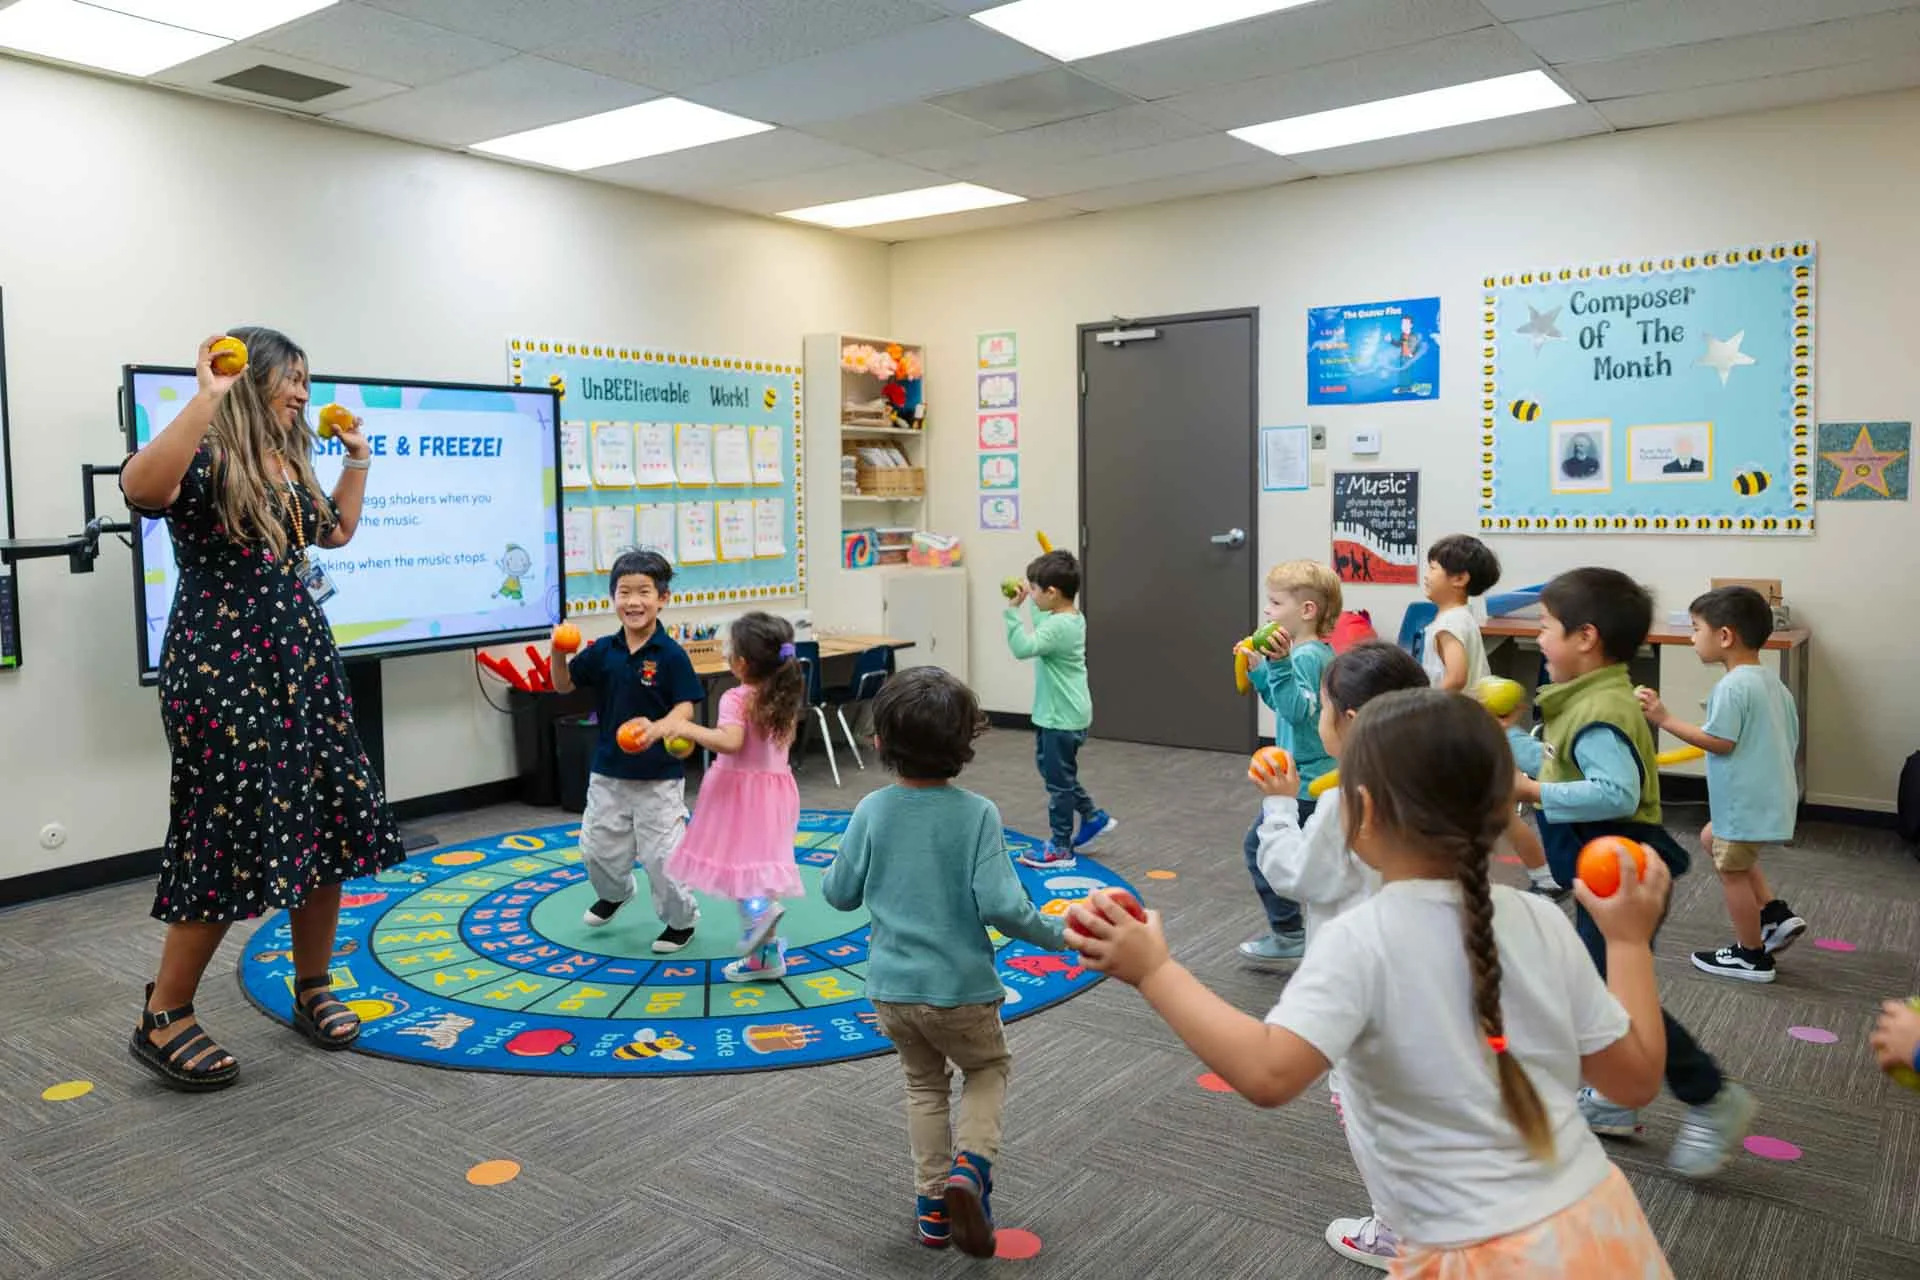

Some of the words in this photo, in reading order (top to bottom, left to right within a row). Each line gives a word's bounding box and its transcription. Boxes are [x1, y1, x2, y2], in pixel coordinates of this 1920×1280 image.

[1570, 286, 1696, 318] Composer
[1579, 320, 1611, 350] Of
[1636, 317, 1685, 345] The
[1593, 351, 1673, 381] Month
[582, 376, 690, 404] UnBEElievable
[710, 384, 750, 408] Work!
[396, 435, 411, 457] &
[419, 436, 503, 458] FREEZE!
[1346, 473, 1407, 496] Music
[389, 490, 437, 507] shakers
[439, 491, 469, 505] when
[471, 493, 492, 506] you
[359, 514, 381, 527] the
[357, 555, 392, 571] when
[394, 554, 414, 569] the
[416, 554, 452, 568] music
[378, 929, 452, 945] Ww
[826, 944, 860, 957] 5
[546, 954, 597, 974] 26
[663, 966, 698, 978] 2
[803, 975, 857, 999] Dd
[1000, 968, 1047, 987] fish
[482, 979, 543, 1001] Zz
[558, 986, 608, 1011] Aa
[729, 986, 767, 1008] Cc
[644, 991, 686, 1014] Bb
[359, 1005, 443, 1039] zebra
[830, 1017, 864, 1042] dog
[464, 1020, 527, 1056] apple
[589, 1032, 626, 1058] bee
[714, 1027, 742, 1058] cake
